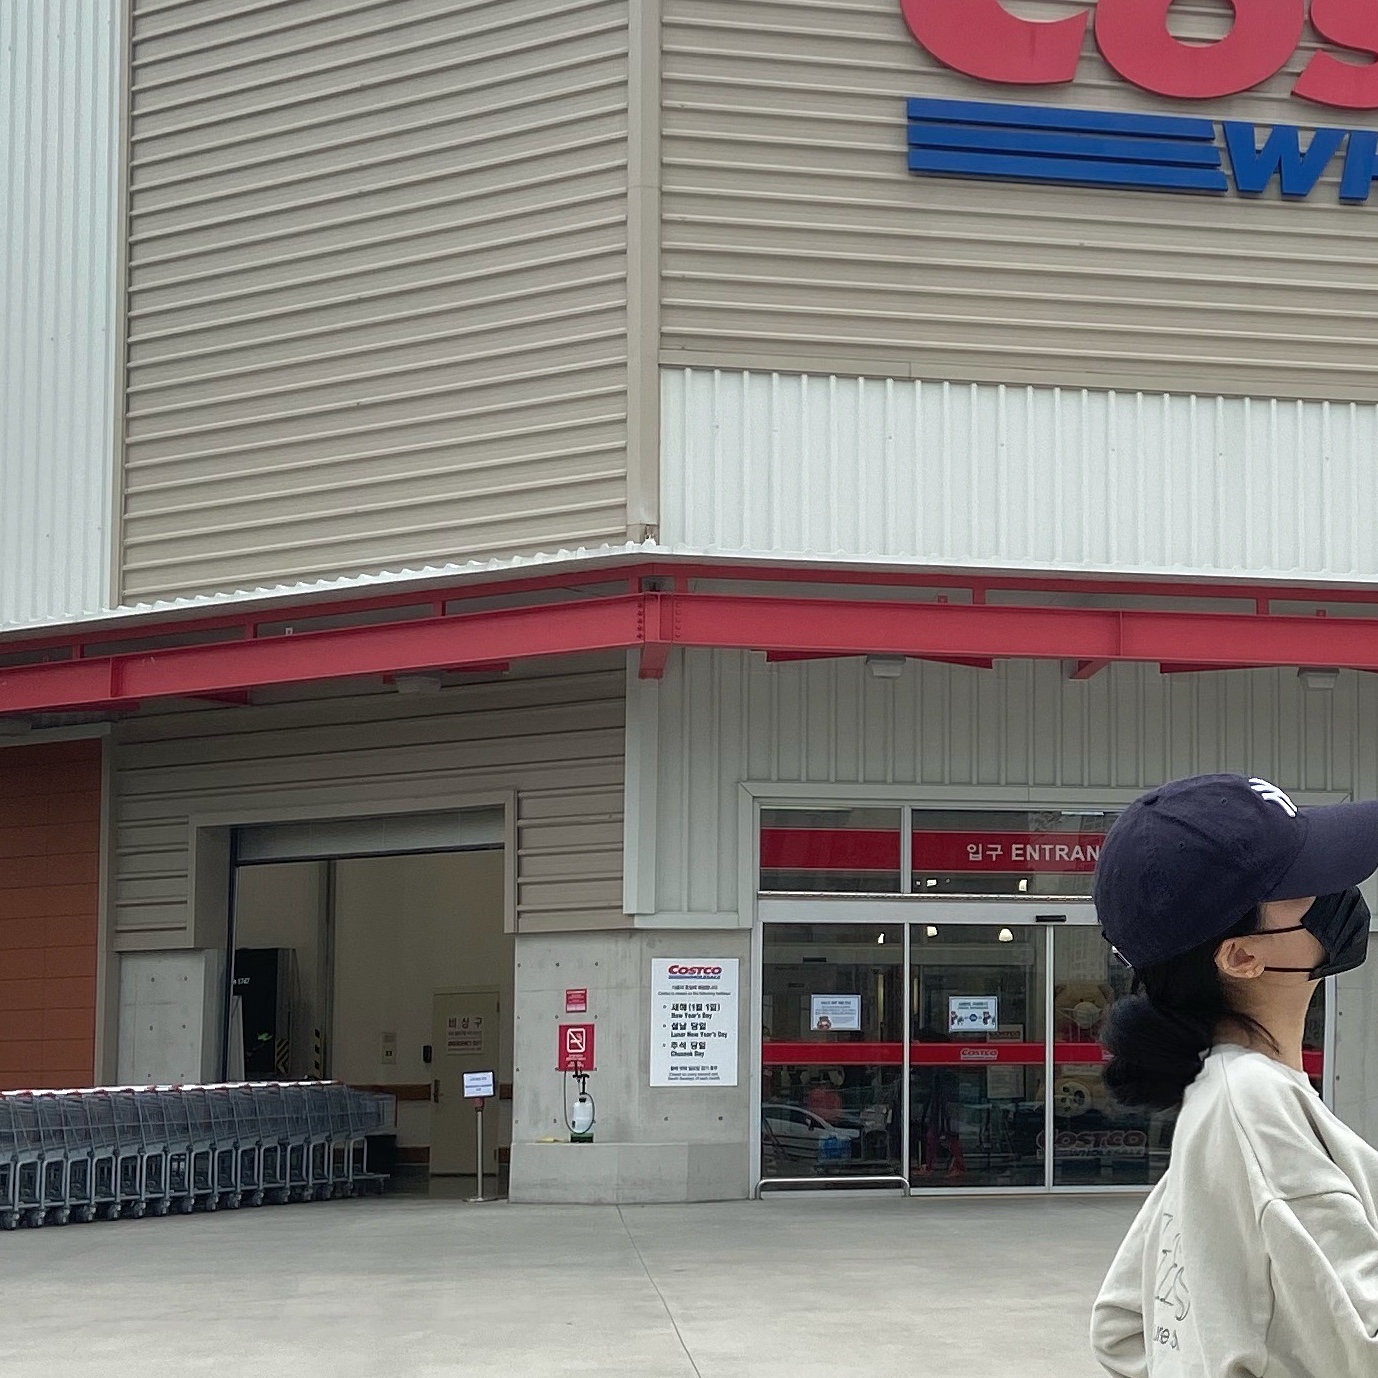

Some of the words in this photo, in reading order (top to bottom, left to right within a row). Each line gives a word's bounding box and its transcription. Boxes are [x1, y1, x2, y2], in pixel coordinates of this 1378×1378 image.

[966, 843, 1003, 861] 입구
[668, 964, 722, 975] COSTCO
[961, 1048, 997, 1056] COSTCO
